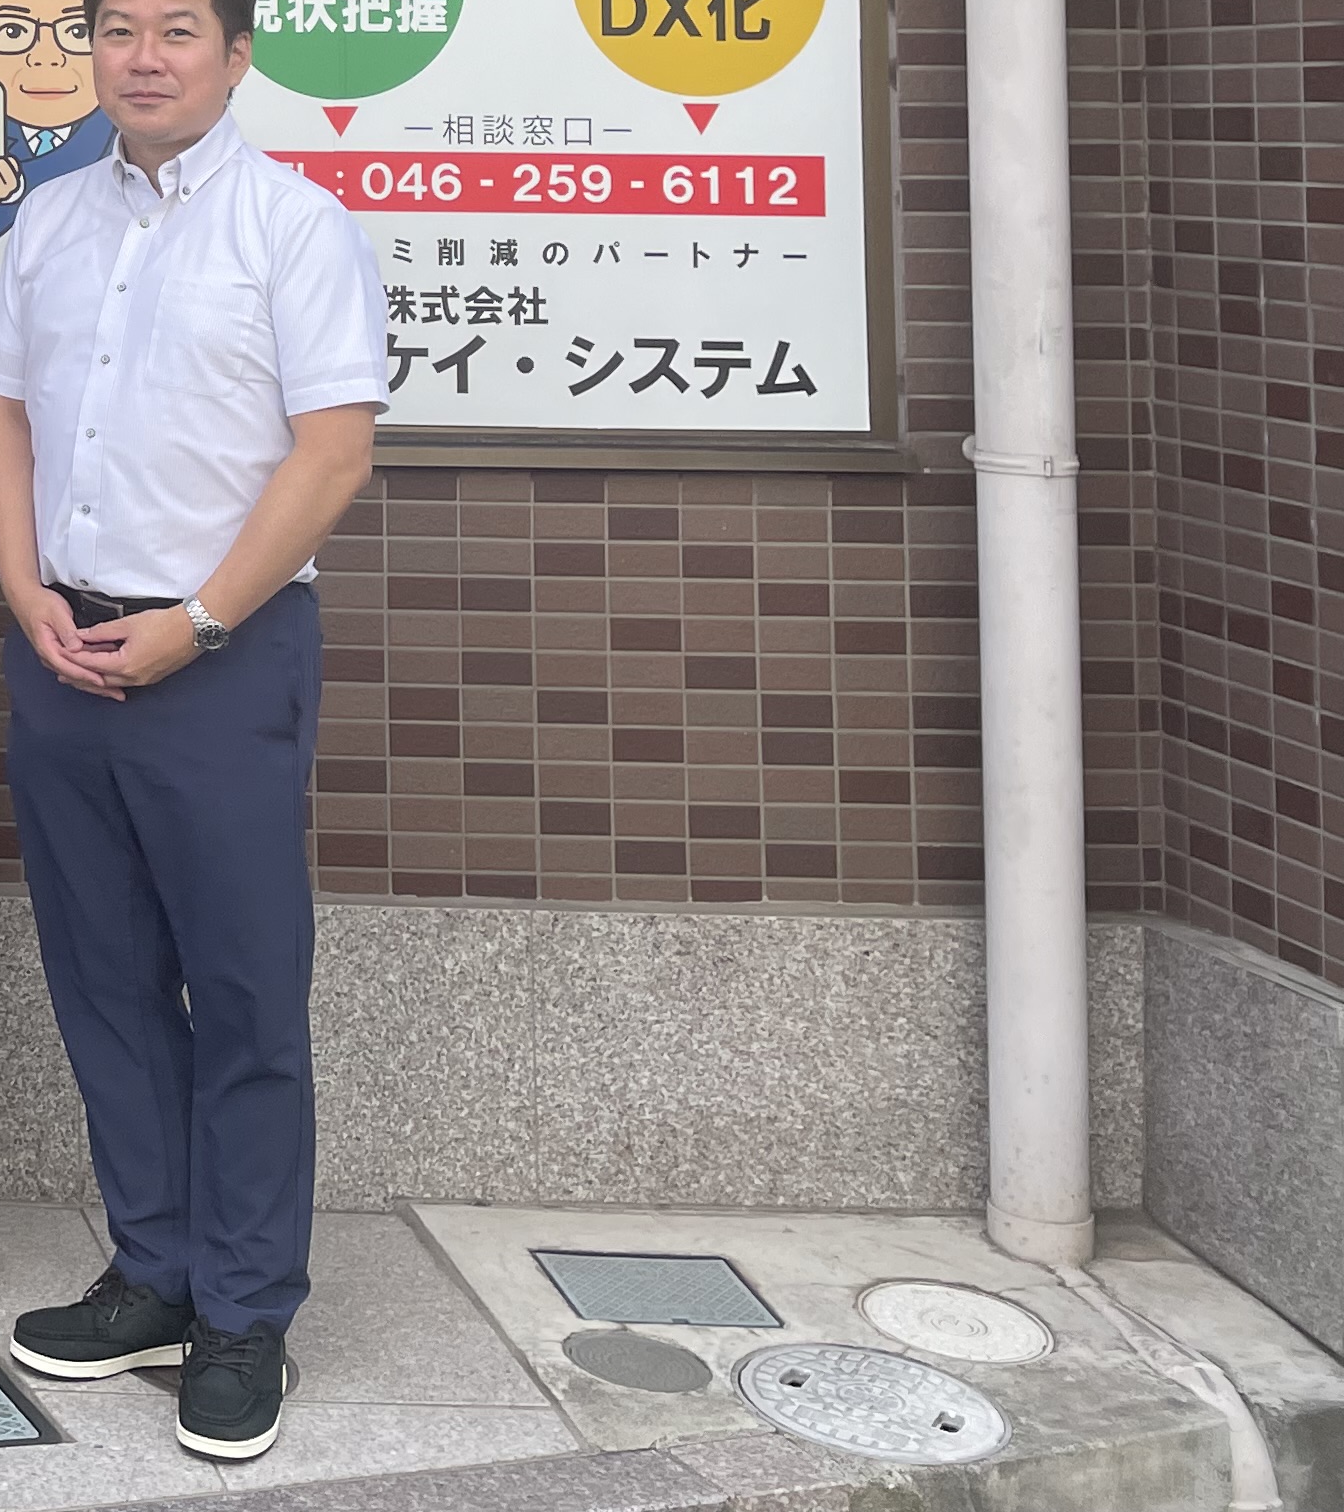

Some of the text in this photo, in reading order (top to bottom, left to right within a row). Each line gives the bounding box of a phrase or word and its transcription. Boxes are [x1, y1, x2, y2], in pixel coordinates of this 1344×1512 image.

[387, 332, 819, 399] ケイ・システム
